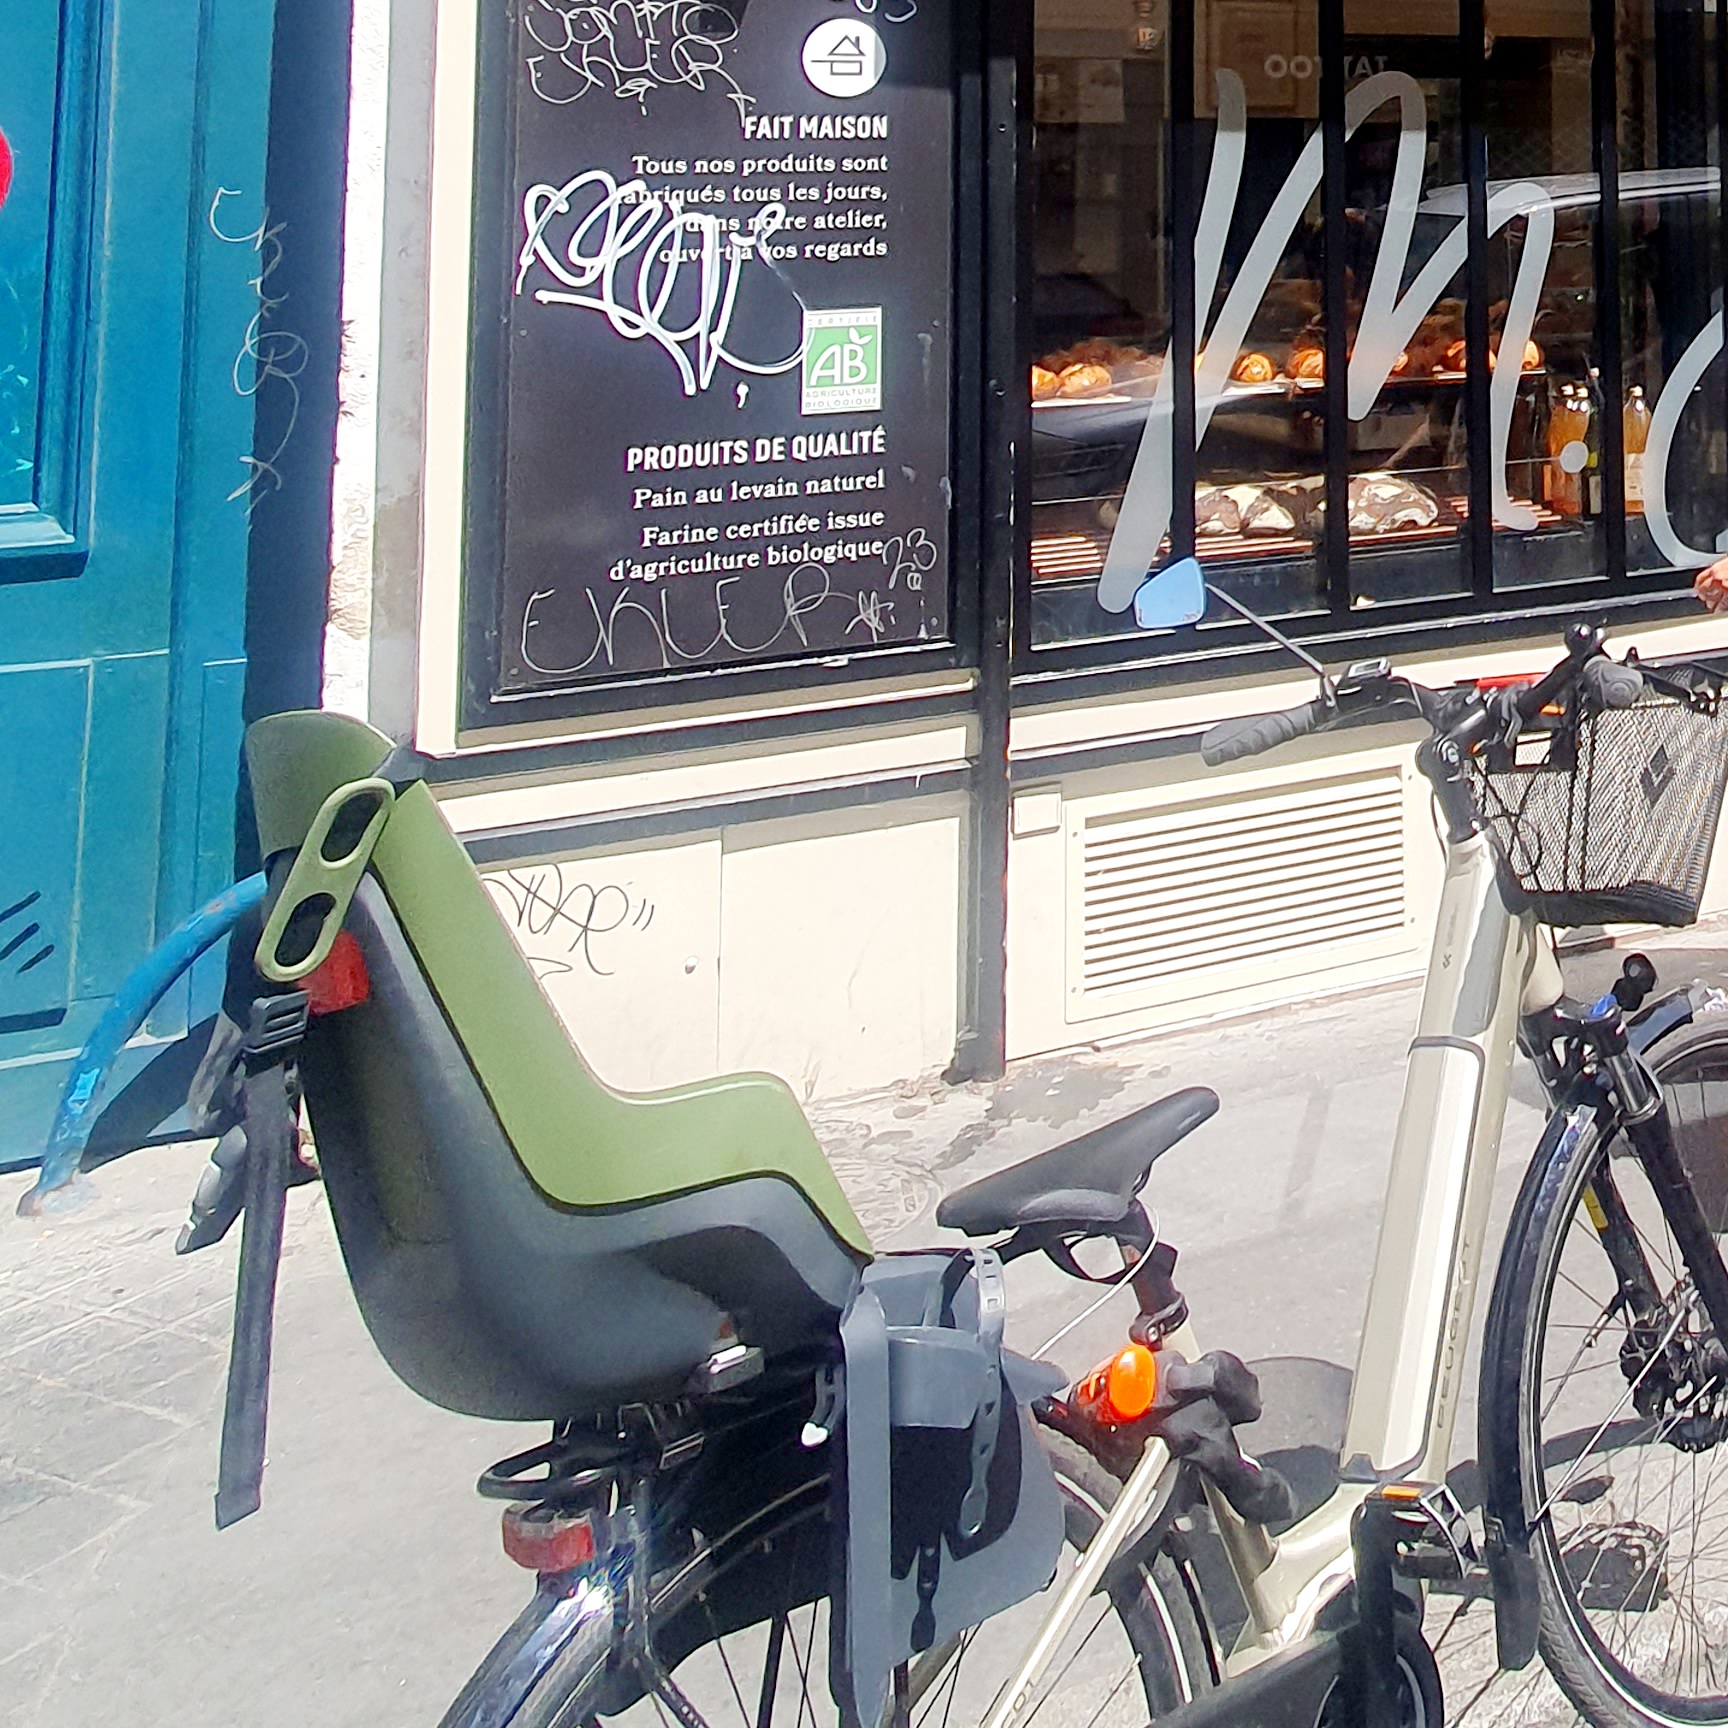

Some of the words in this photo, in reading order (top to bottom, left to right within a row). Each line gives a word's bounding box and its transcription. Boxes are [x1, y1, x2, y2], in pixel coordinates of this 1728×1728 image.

[743, 116, 793, 140] FAIT
[798, 114, 888, 140] MAISON
[632, 155, 687, 174] Tous
[694, 159, 735, 174] nos
[741, 155, 837, 177] produits
[841, 155, 888, 172] sont
[733, 186, 782, 203] tous
[787, 183, 821, 202] les
[823, 184, 888, 204] jours,
[813, 212, 888, 232] atelier,
[803, 239, 888, 261] regards
[808, 343, 868, 387] AB
[805, 387, 877, 399] AGRICULTURE
[805, 397, 877, 409] BIOLOGIQUE
[627, 437, 748, 472] PRODUITS
[755, 435, 785, 464] DE
[791, 425, 887, 461] QUALITÉ
[633, 486, 688, 510] Pain
[695, 485, 725, 503] au
[731, 477, 799, 501] levain
[805, 469, 886, 496] naturel
[642, 523, 719, 547] Farine
[725, 513, 820, 539] certifiée
[827, 508, 885, 530] issue
[609, 551, 760, 582] d'agriculture
[767, 538, 884, 568] biologique
